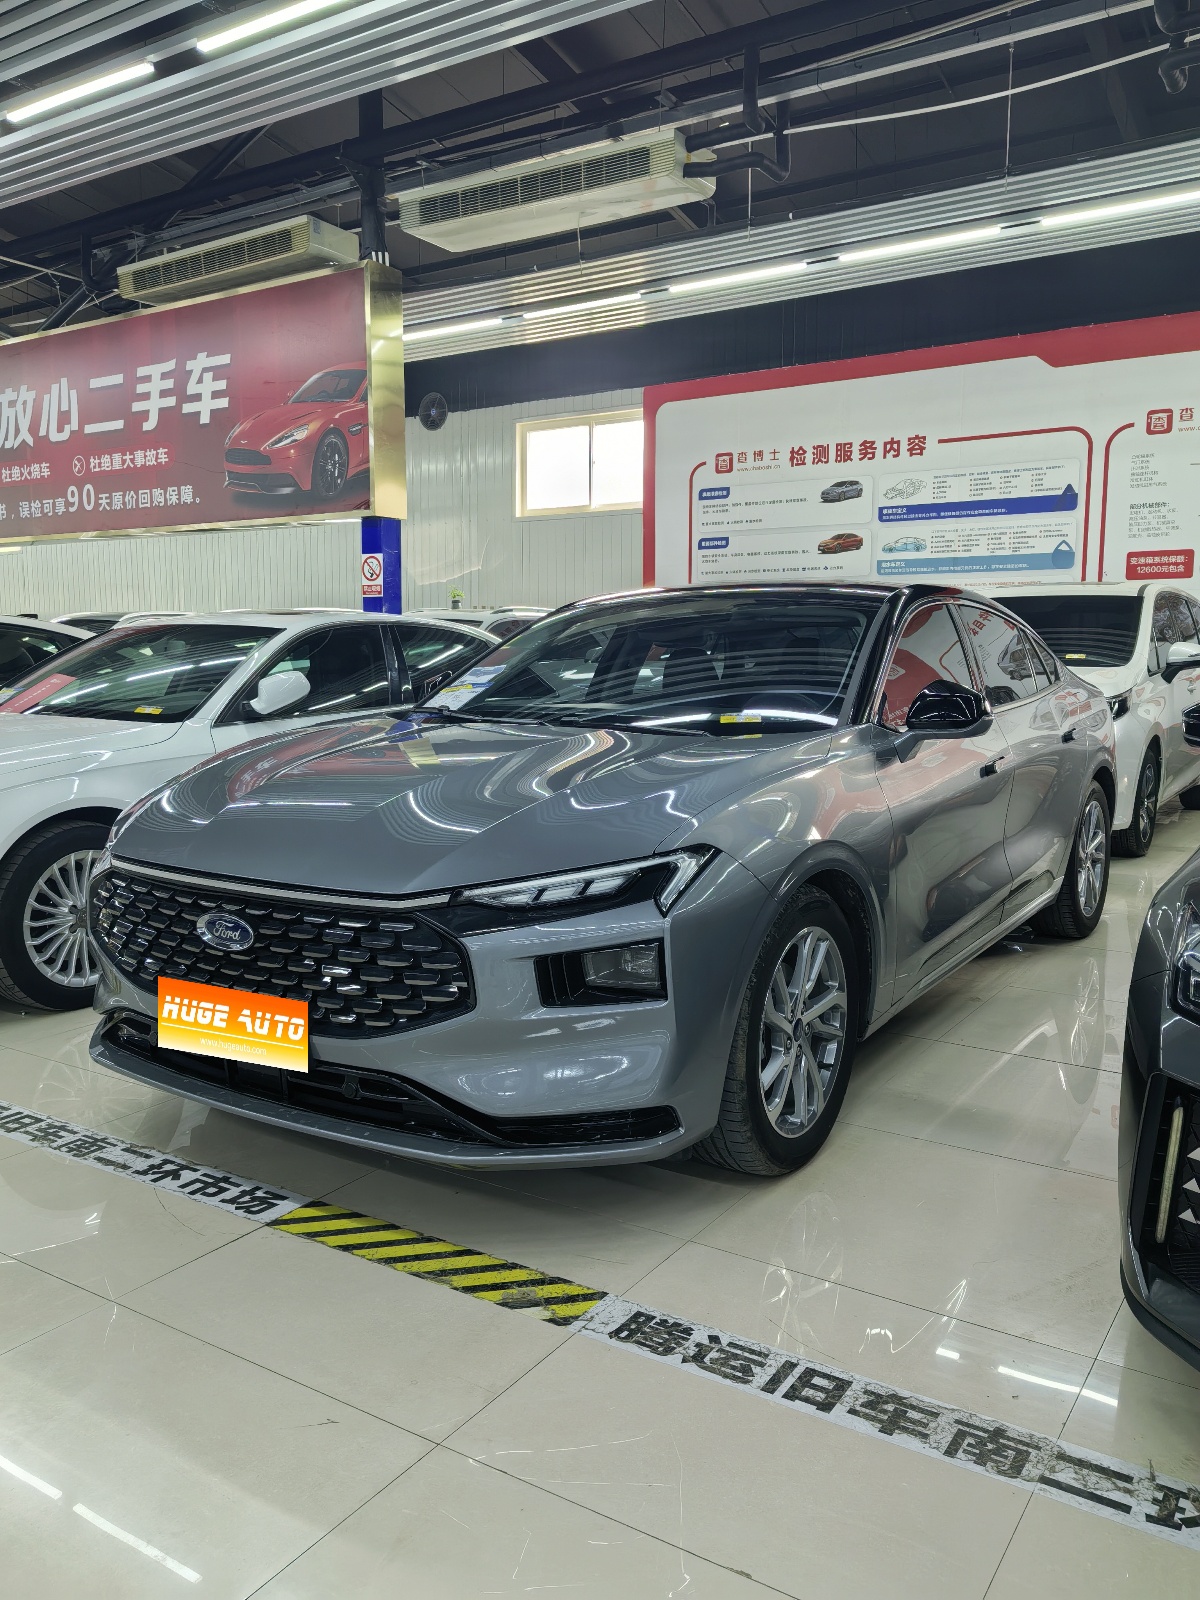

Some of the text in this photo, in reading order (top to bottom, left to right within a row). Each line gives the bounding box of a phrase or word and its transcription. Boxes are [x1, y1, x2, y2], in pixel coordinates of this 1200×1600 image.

[0, 352, 231, 449] 放心二手车
[1, 447, 169, 483] 杜绝火烧车 杜绝重大事故车
[788, 434, 928, 467] 检测服务内容
[213, 920, 241, 941] Ford
